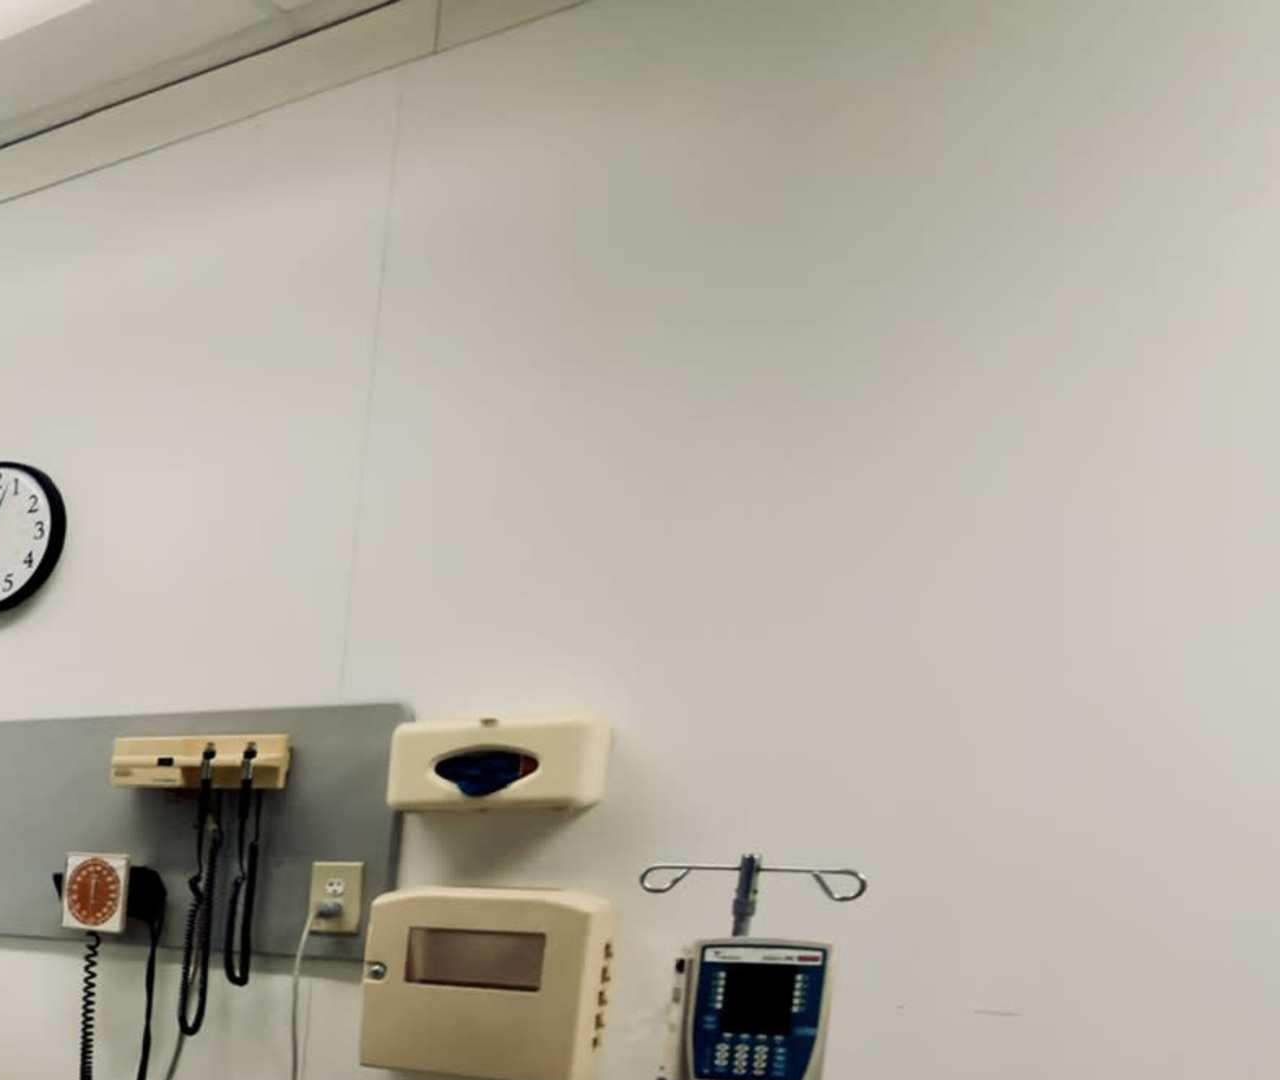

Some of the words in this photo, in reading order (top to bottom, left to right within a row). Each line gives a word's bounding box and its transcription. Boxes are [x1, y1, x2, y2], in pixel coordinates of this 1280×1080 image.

[13, 478, 20, 496] 1
[27, 495, 39, 514] 2
[33, 520, 45, 540] 3
[23, 550, 34, 569] 4
[2, 573, 14, 592] 5
